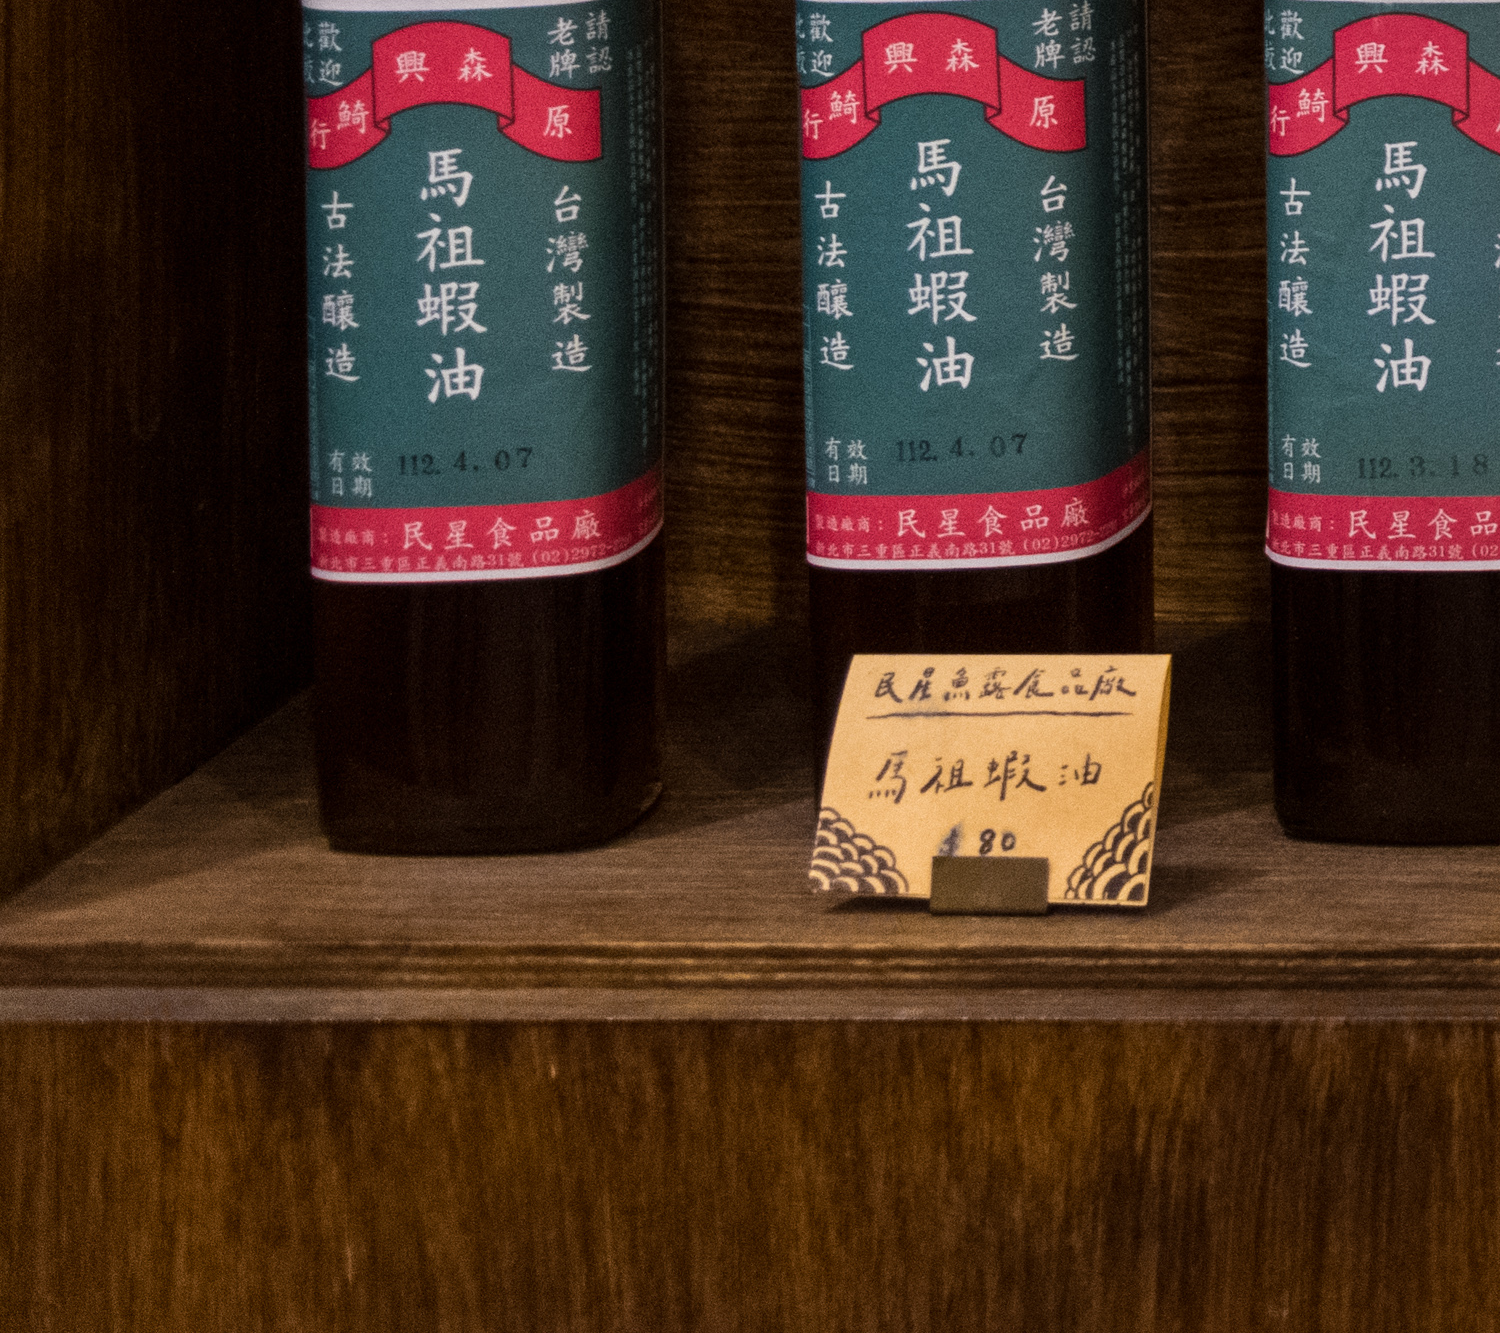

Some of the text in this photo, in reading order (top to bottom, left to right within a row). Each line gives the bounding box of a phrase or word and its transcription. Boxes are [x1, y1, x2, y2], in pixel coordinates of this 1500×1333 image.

[320, 189, 362, 383] 古法釀造
[416, 147, 488, 404] 馬祖蝦油
[545, 184, 594, 373] 台灣製造
[814, 180, 855, 371] 古法釀造
[906, 137, 978, 392] 馬祖蝦油
[1032, 174, 1080, 361] 台灣製造
[1278, 177, 1314, 369] 古法釀造
[1366, 139, 1437, 394] 馬祖蝦油
[402, 509, 602, 551] 民星食品廠
[896, 497, 1089, 539] 民星食品廠
[867, 749, 1103, 805] 馬祖蝦油
